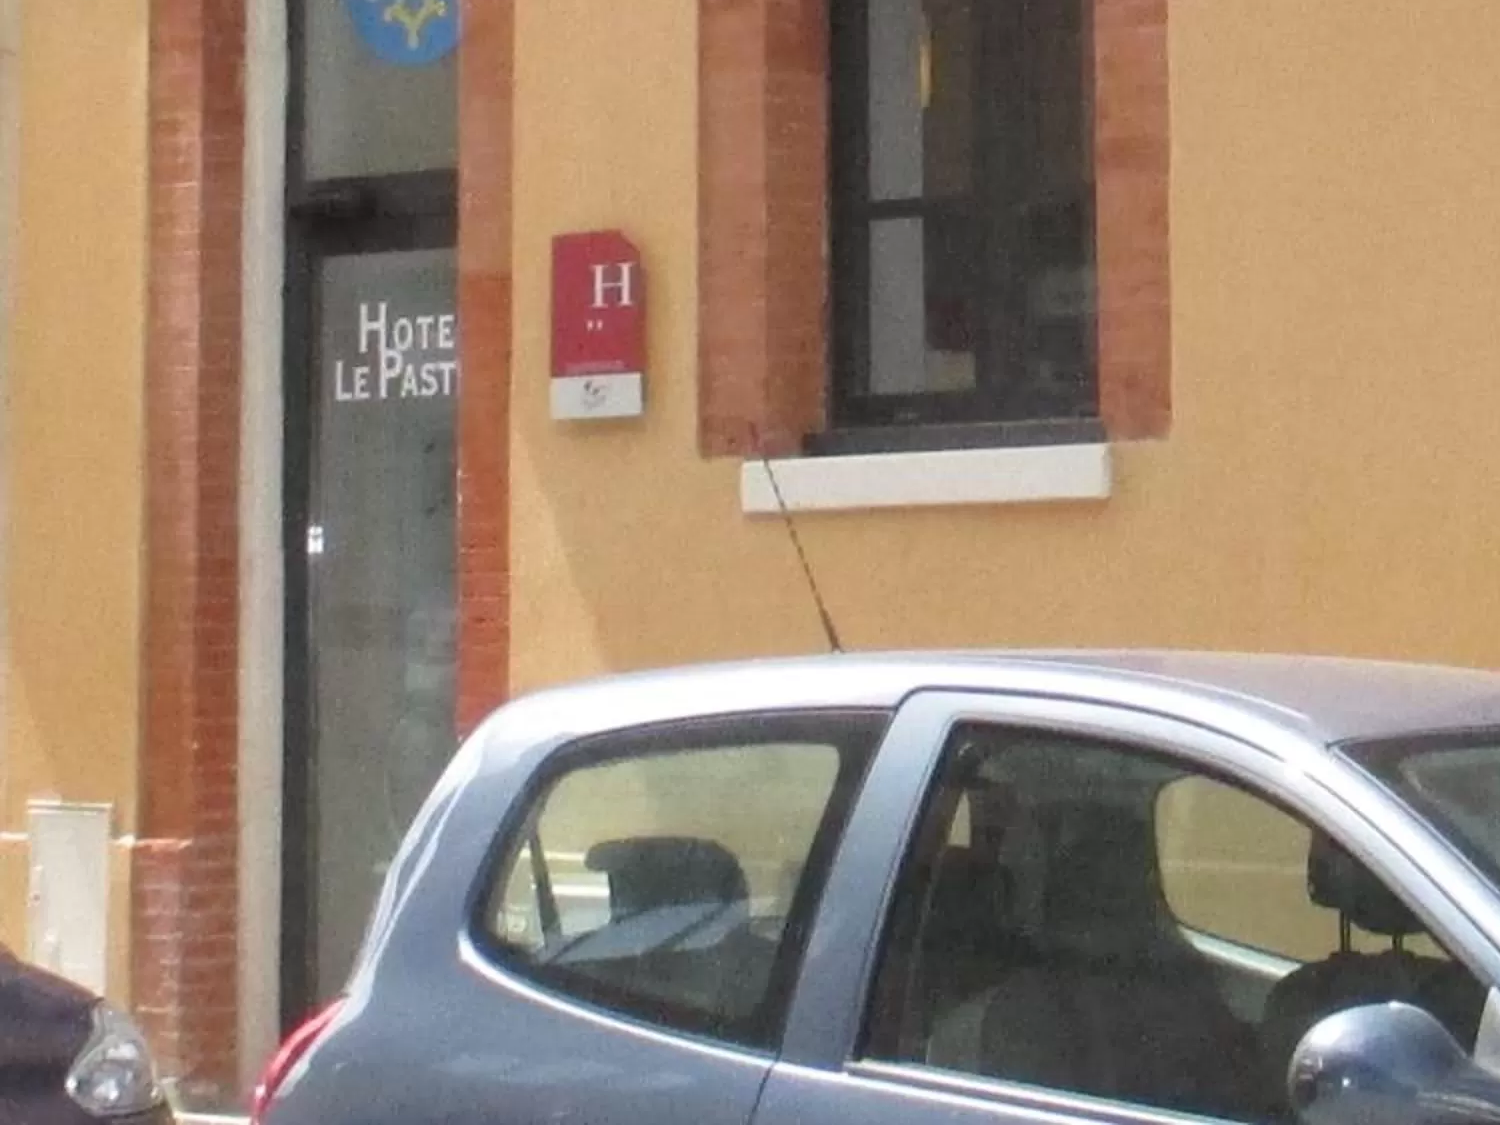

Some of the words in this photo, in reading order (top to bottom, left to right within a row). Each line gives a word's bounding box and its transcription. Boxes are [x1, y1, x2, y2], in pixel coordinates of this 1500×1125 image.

[589, 261, 637, 309] H
[358, 301, 455, 354] HOTE
[335, 360, 371, 402] LE
[379, 349, 459, 399] PAST
